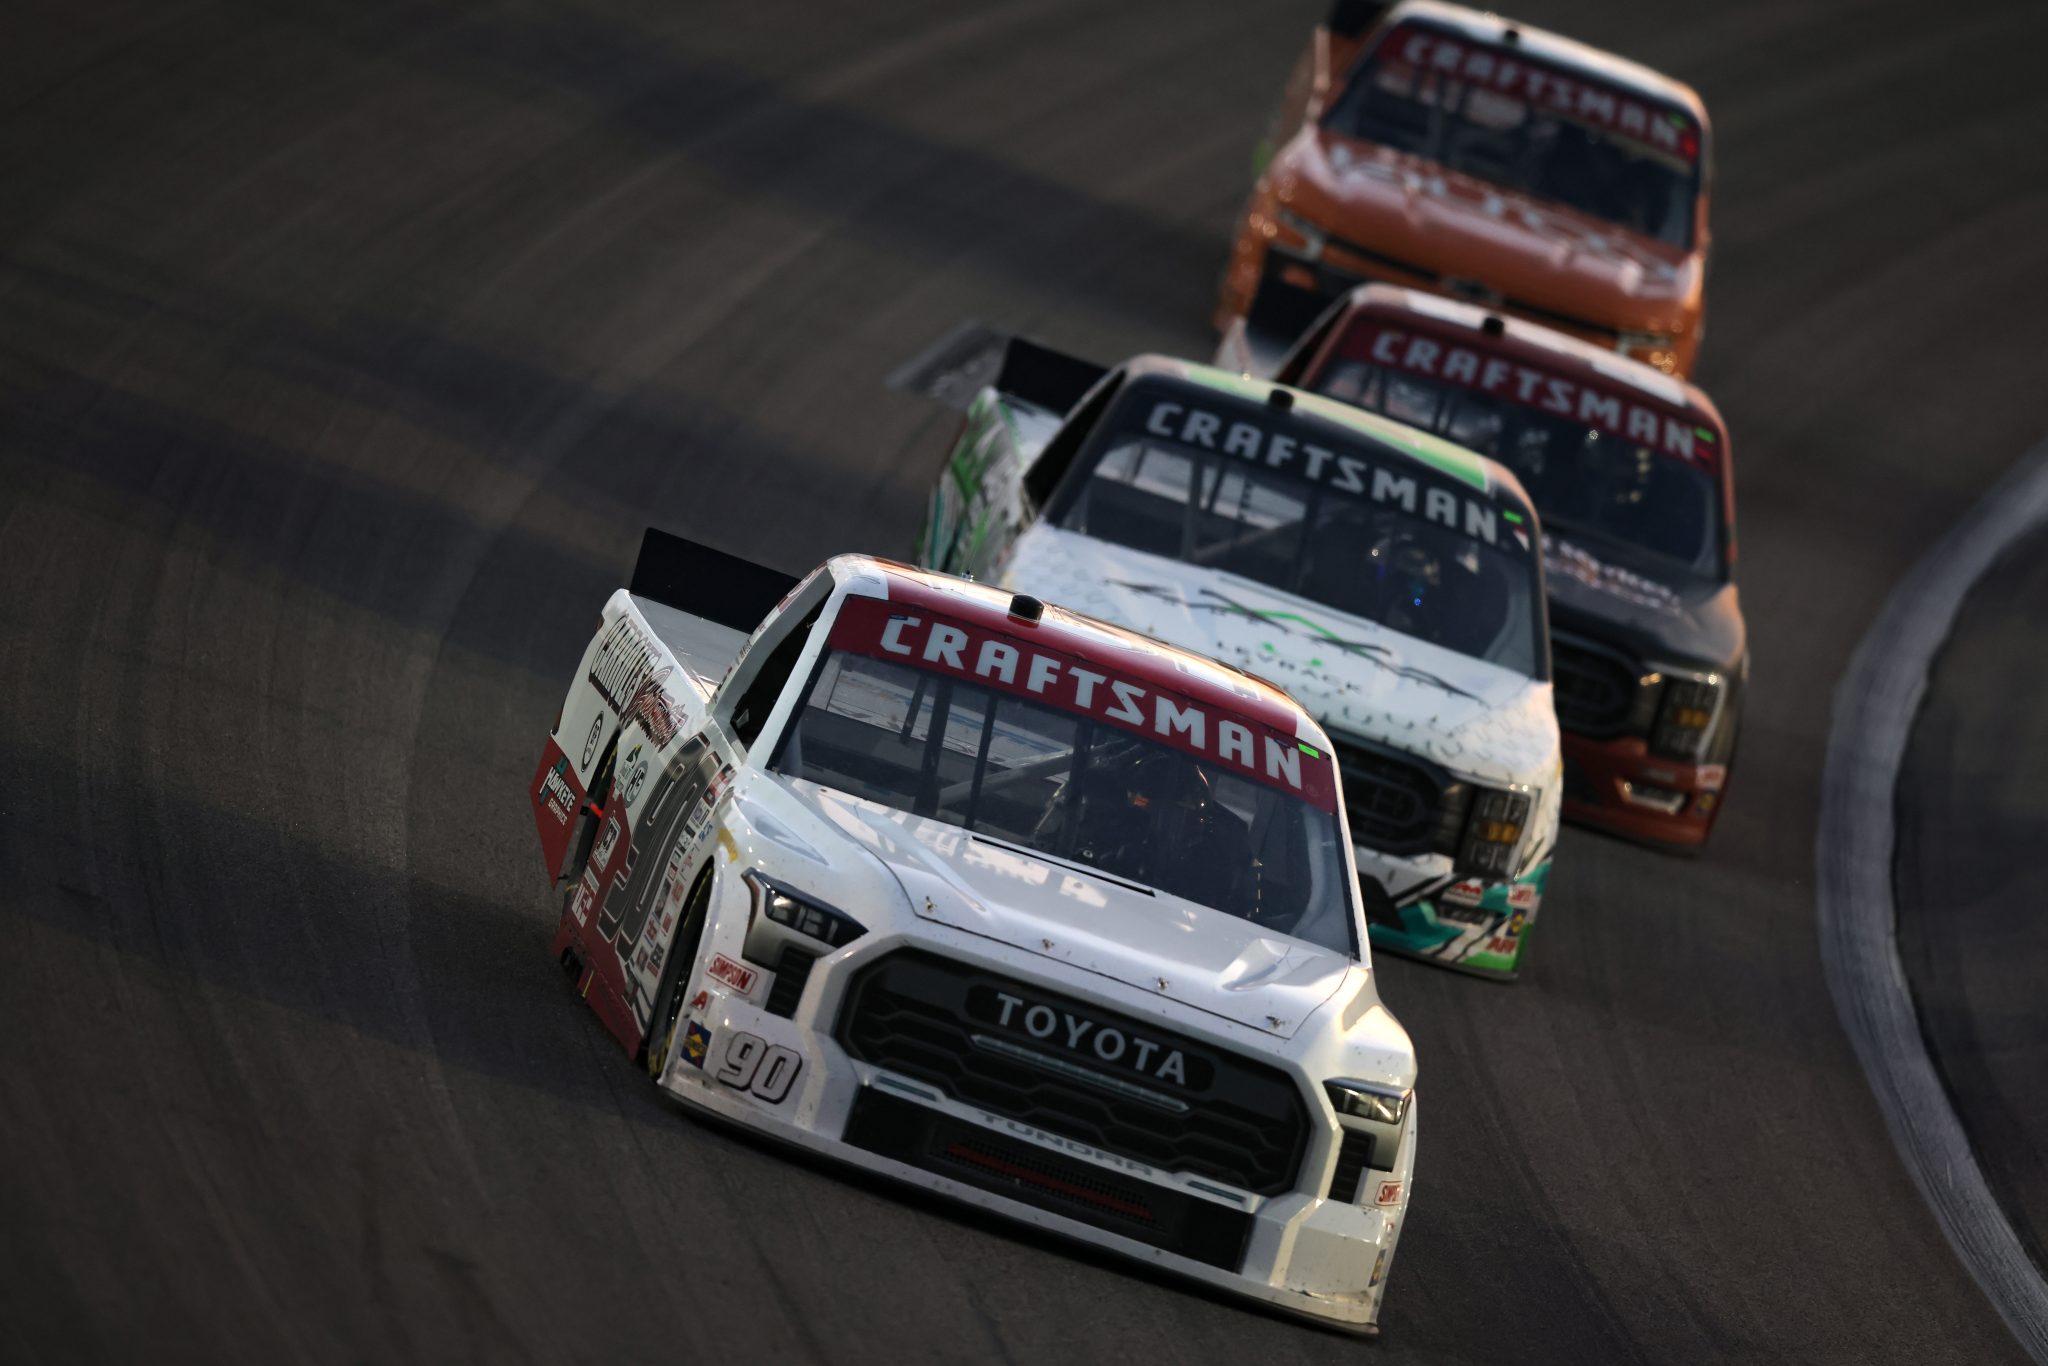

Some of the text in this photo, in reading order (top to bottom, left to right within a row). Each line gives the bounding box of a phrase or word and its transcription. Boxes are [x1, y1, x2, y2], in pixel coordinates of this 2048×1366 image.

[1403, 33, 1683, 149] CRAFTSMAN
[1371, 330, 1697, 461] CRAFTSMAN
[1147, 402, 1498, 543] CRAFTSMAN
[879, 613, 1303, 790] CRAFTSMAN
[539, 765, 577, 813] HAWKEYE
[708, 956, 752, 990] SIMPSON
[716, 1030, 803, 1105] 90
[996, 992, 1187, 1086] TOYOTA
[978, 1111, 1154, 1177] TUNDRA
